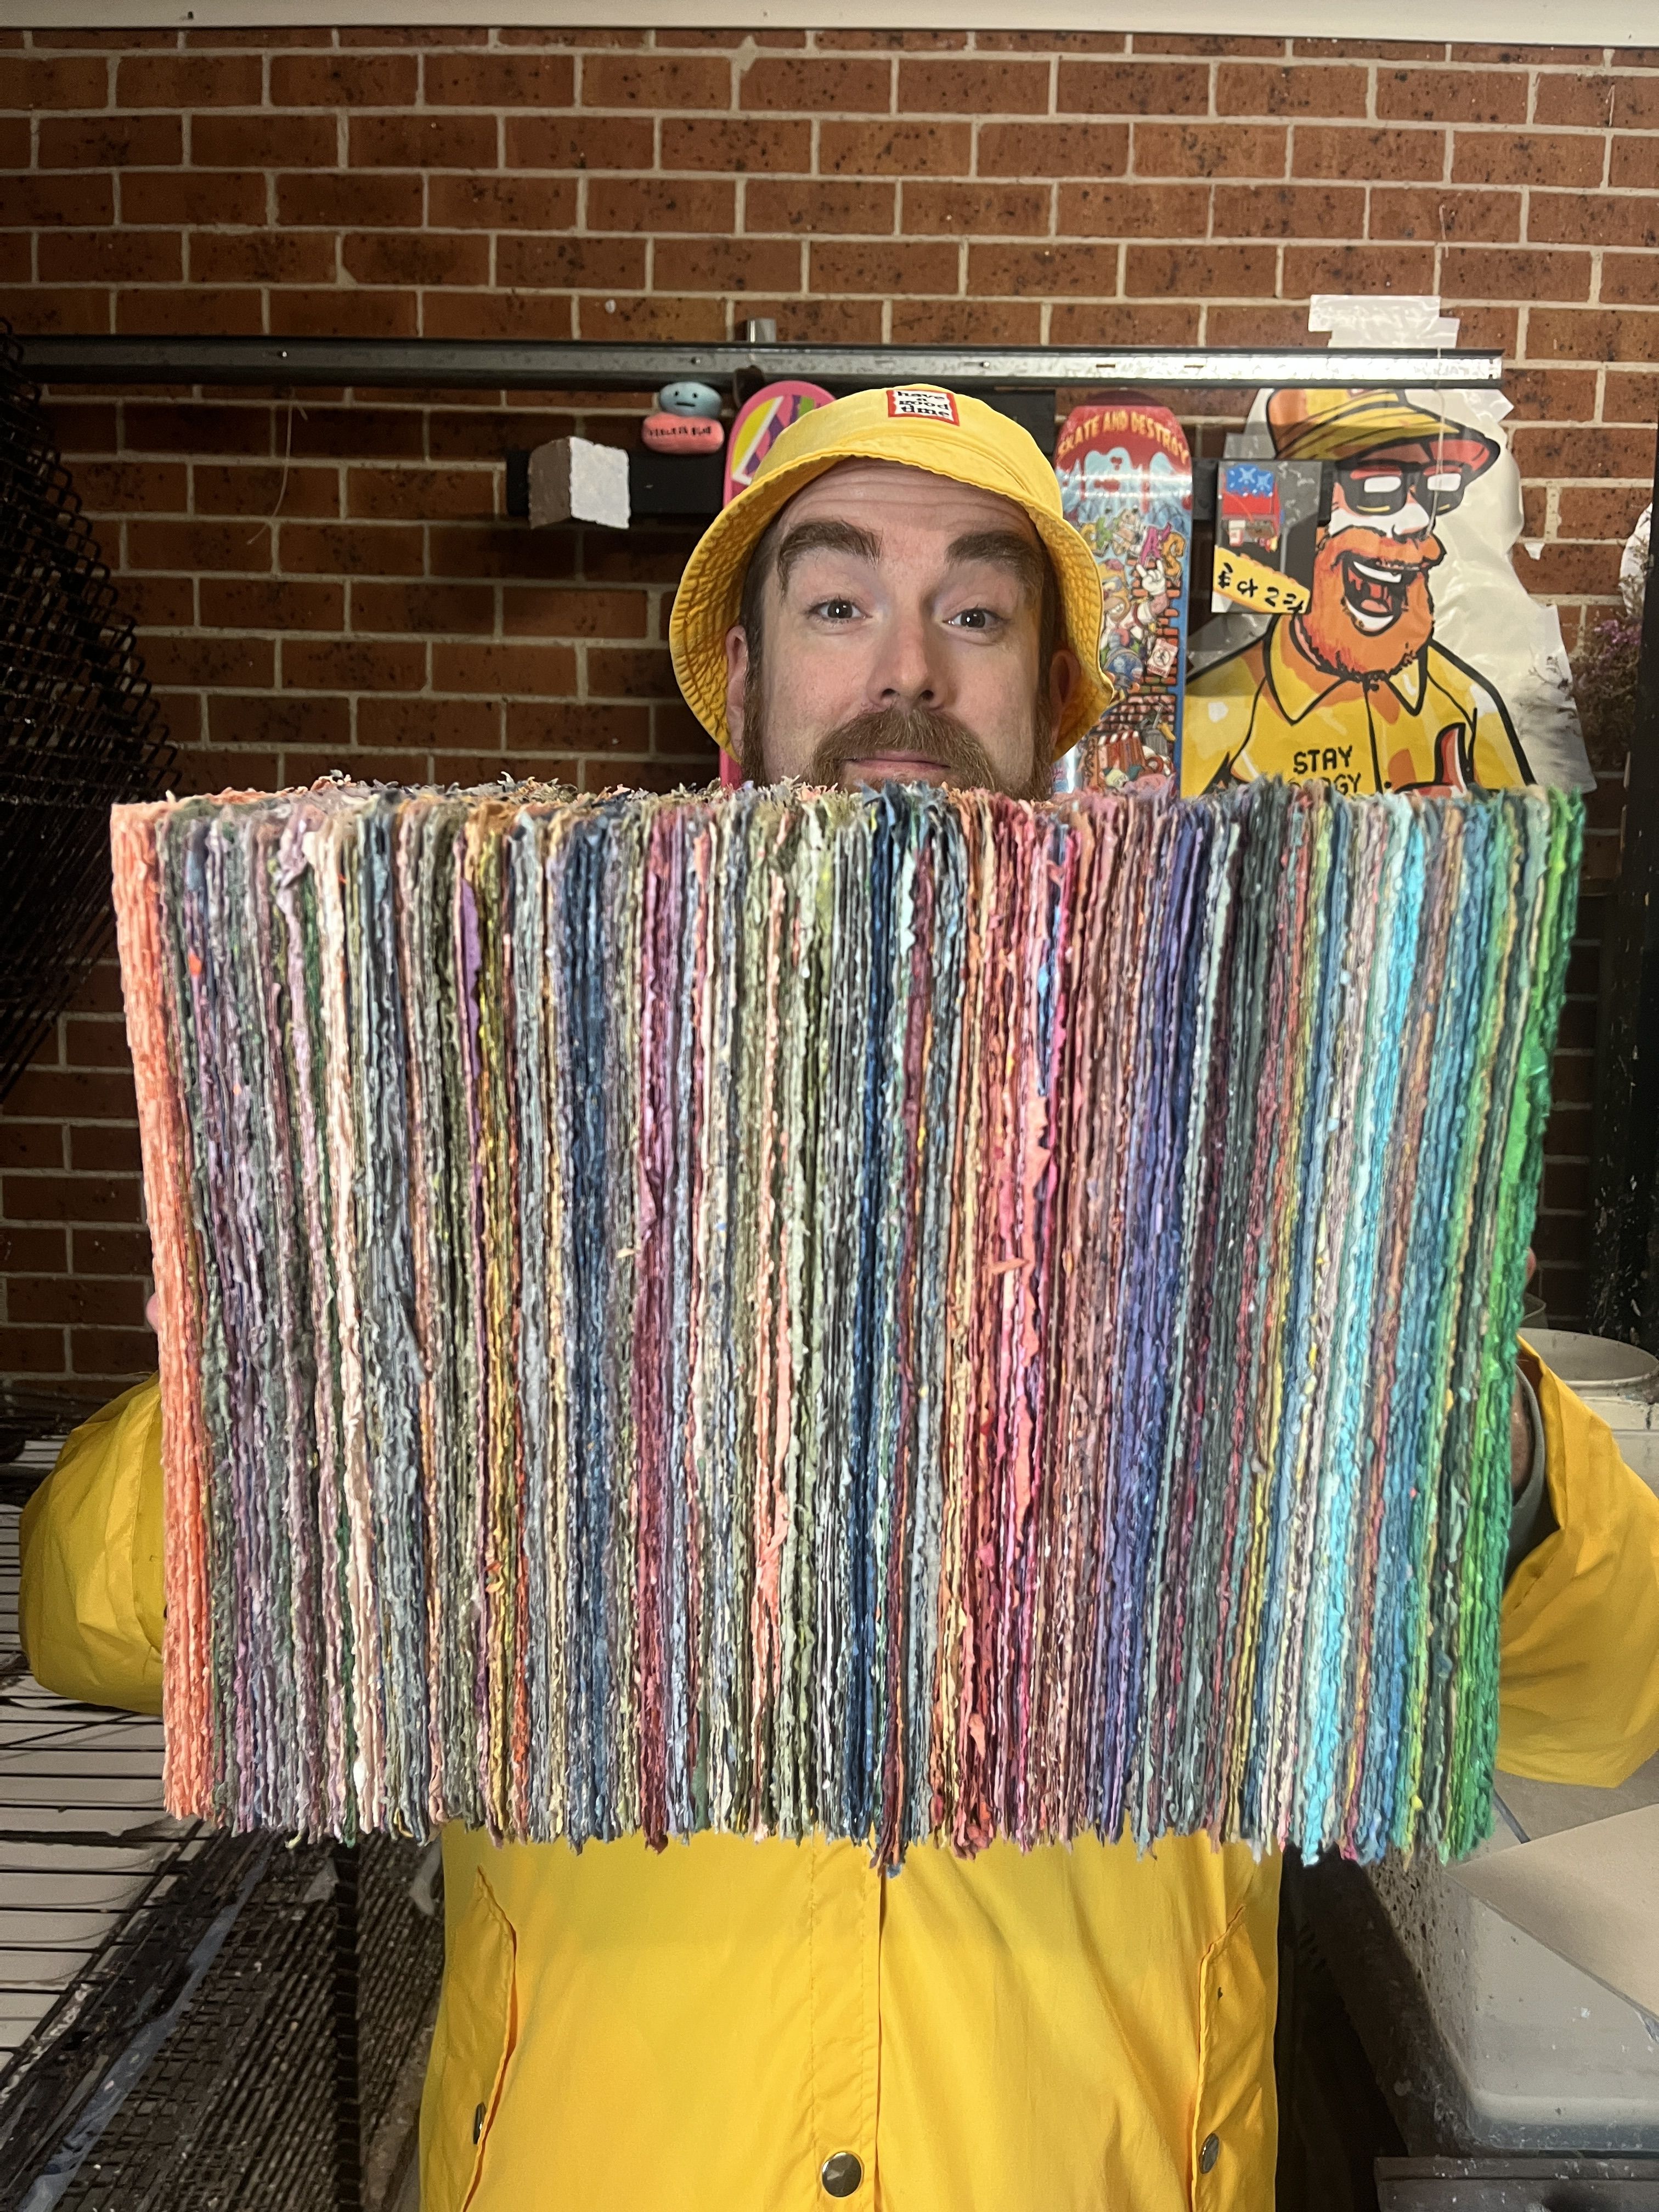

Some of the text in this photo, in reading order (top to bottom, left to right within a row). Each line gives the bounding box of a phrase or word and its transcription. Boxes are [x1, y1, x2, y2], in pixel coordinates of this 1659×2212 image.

[897, 391, 945, 400] have
[899, 400, 949, 410] good
[901, 404, 950, 416] time
[1057, 409, 1189, 465] SKATE AND DESTROY
[1293, 744, 1353, 775] STAY
